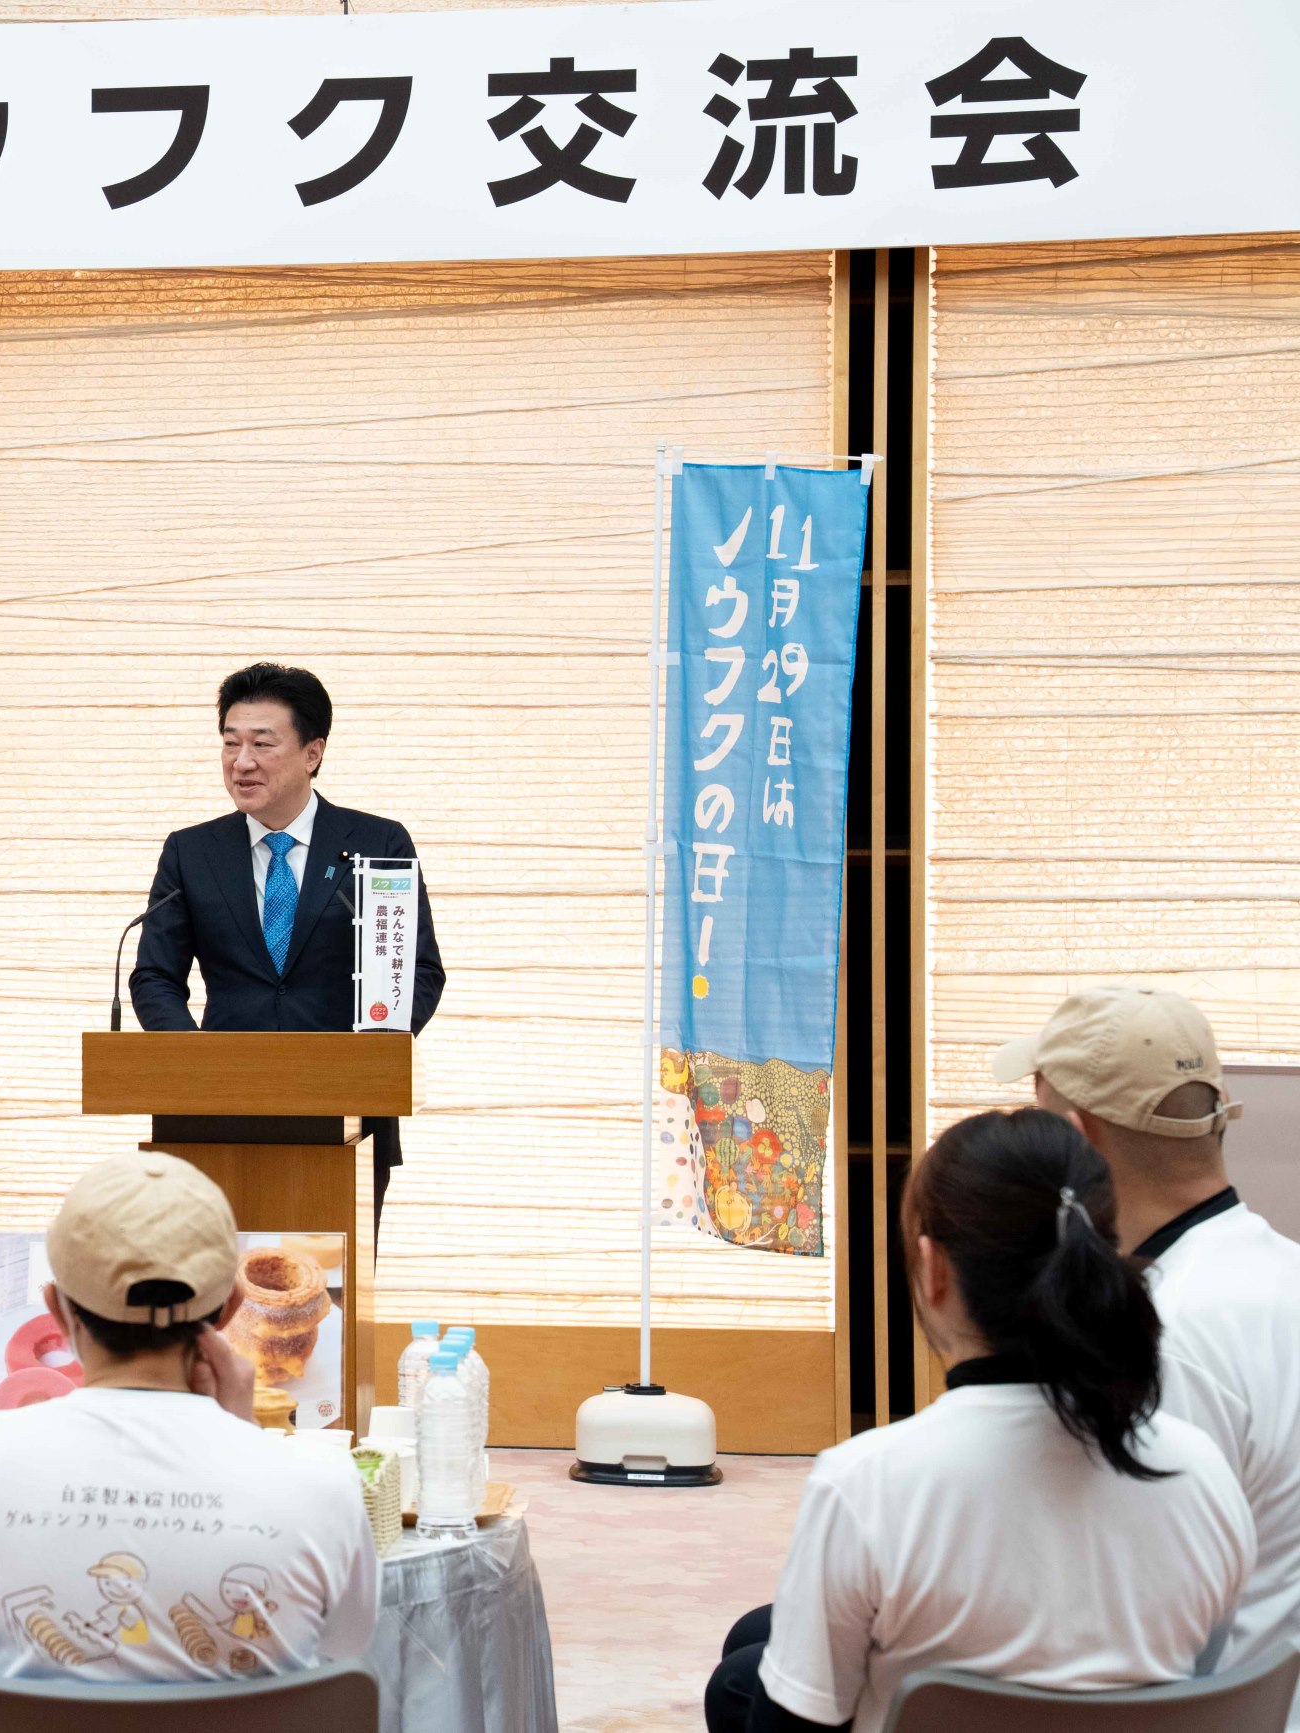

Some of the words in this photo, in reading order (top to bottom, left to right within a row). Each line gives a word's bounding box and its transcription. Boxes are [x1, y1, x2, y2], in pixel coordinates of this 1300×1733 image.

[757, 504, 820, 829] 11月29日は
[373, 880, 409, 888] ノウフク
[375, 905, 388, 956] 農福連携
